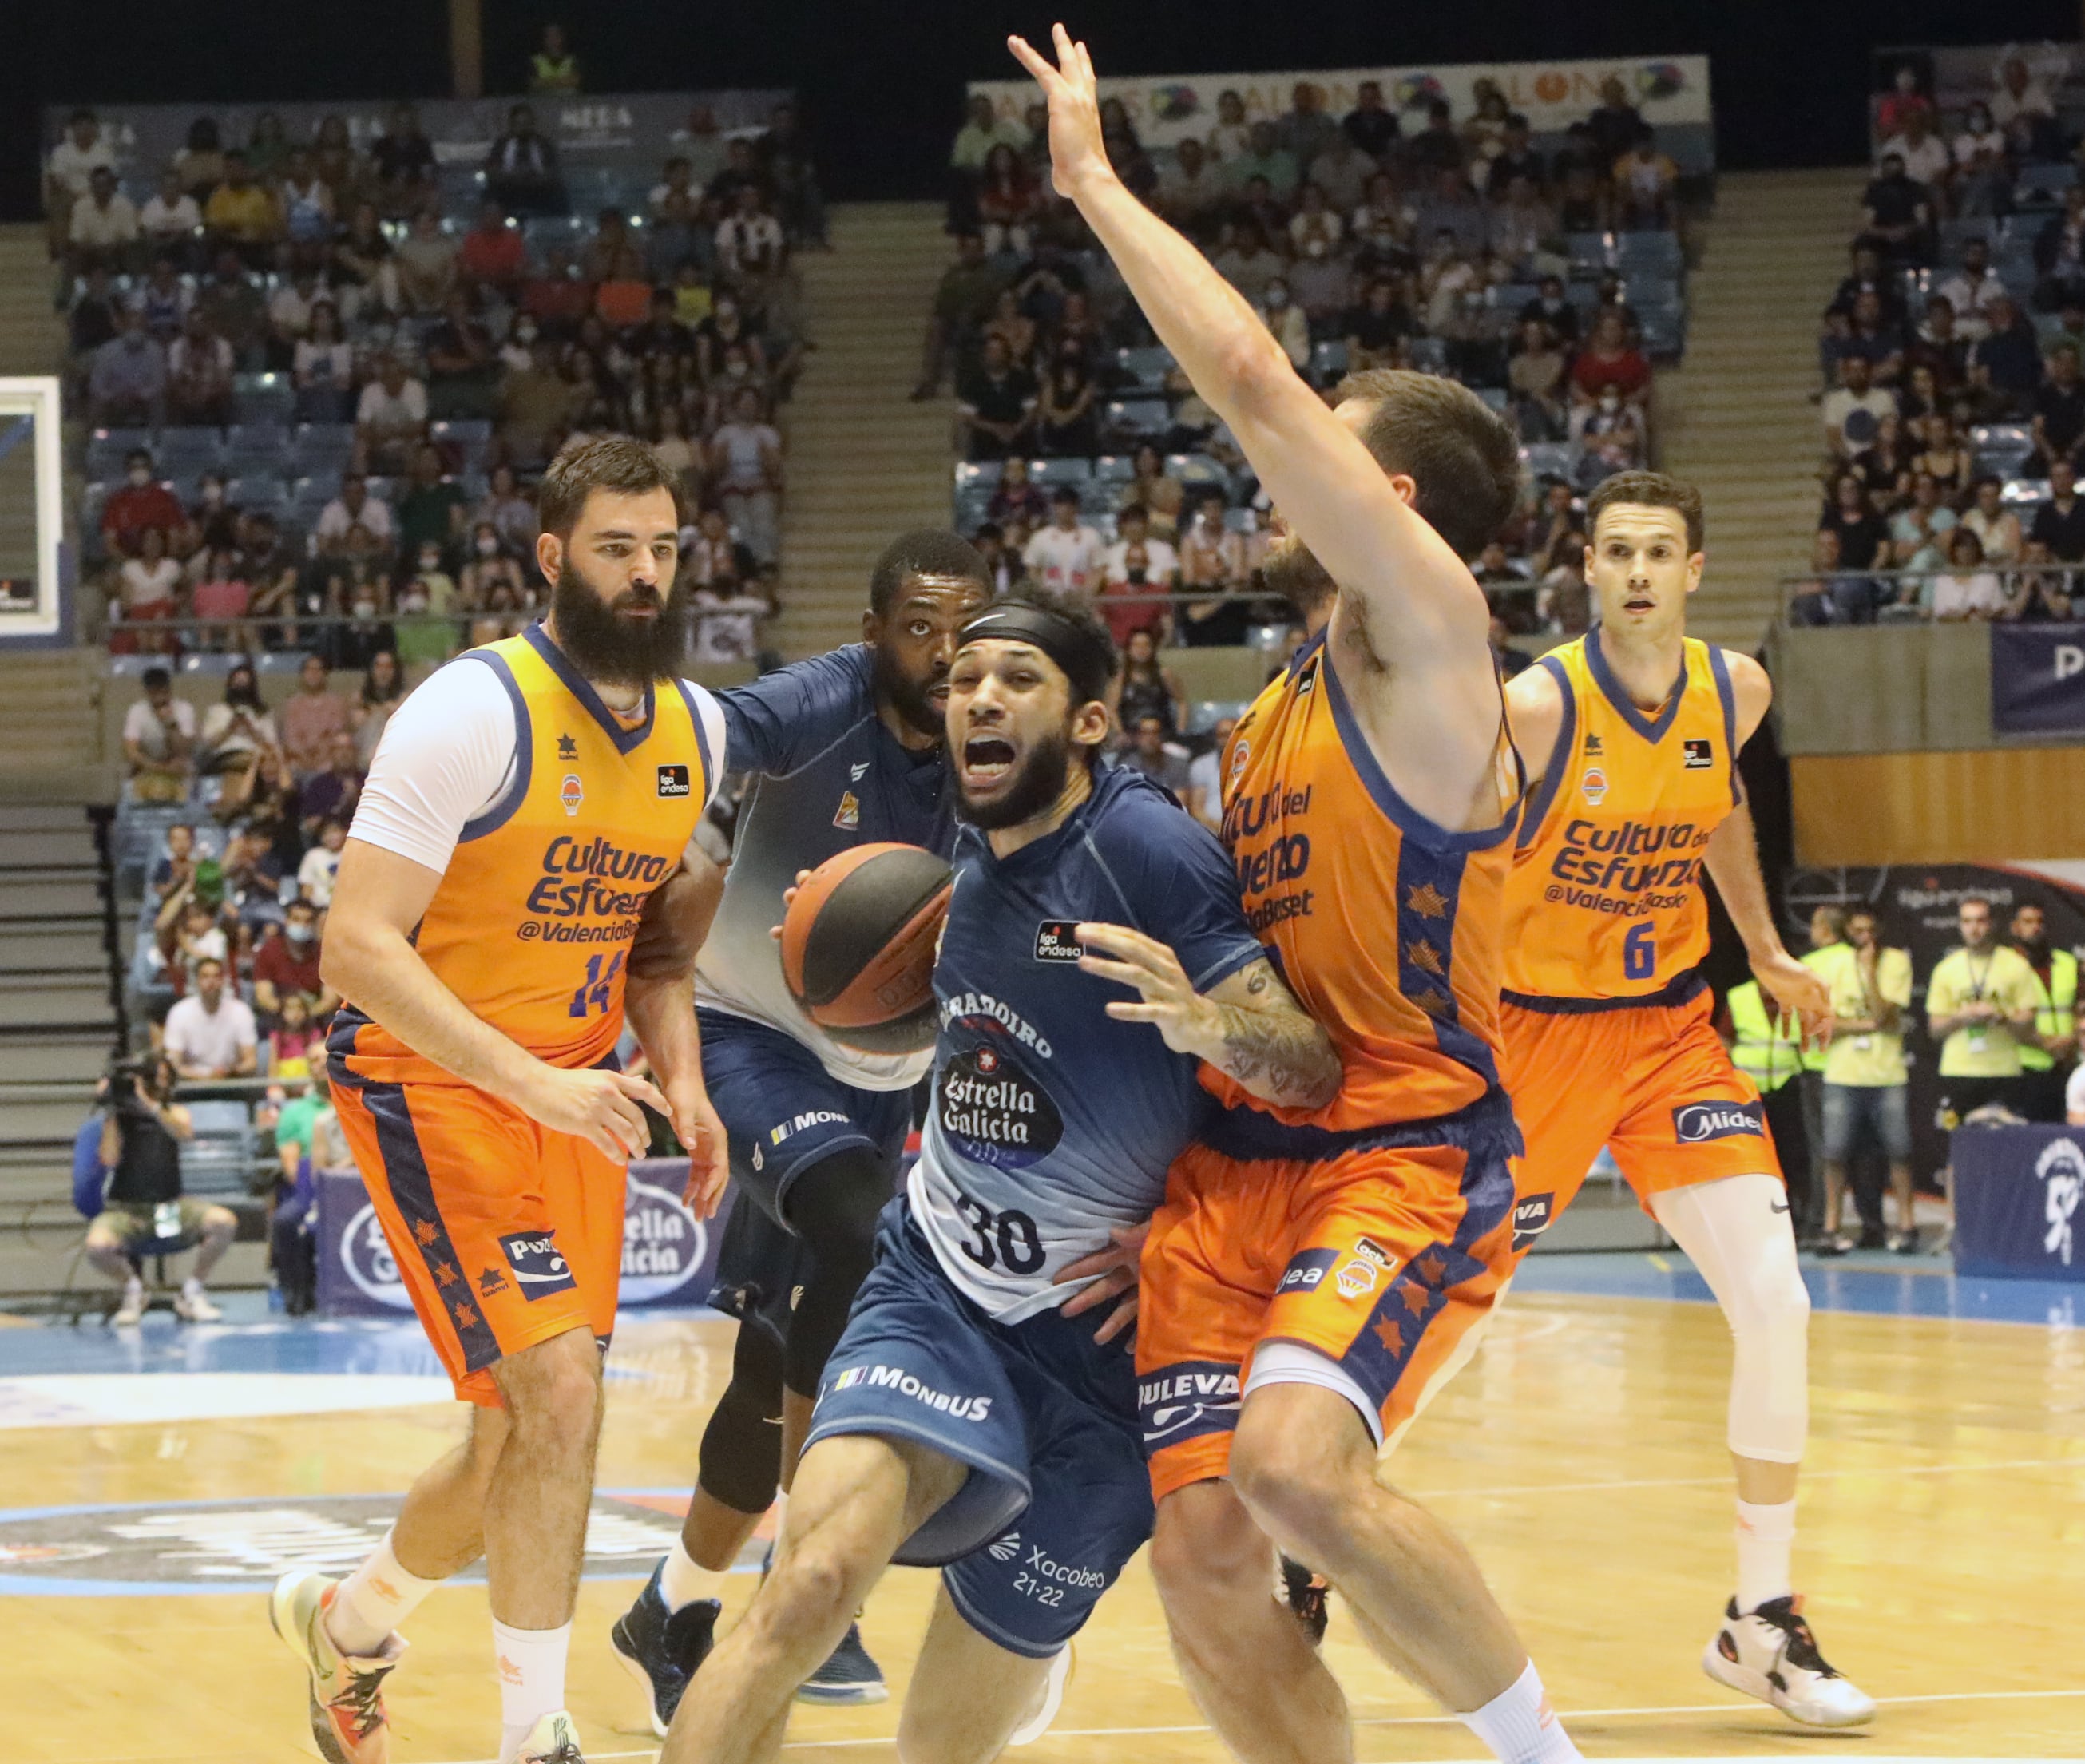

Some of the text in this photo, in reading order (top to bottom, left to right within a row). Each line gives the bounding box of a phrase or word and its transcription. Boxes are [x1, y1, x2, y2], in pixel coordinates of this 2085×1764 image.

[660, 775, 674, 785] liga
[660, 784, 688, 793] endesa
[1038, 945, 1081, 957] endesa
[1040, 933, 1057, 945] liga
[1623, 921, 1655, 980] 6
[569, 950, 624, 1017] 14
[945, 1071, 1036, 1114] Estrella
[794, 1111, 850, 1132] MON
[944, 1100, 1029, 1144] Galicia
[1687, 1108, 1762, 1137] Mide
[624, 1208, 685, 1239] ella
[958, 1195, 1046, 1275] 30
[482, 1282, 509, 1298] luanvi
[867, 1365, 993, 1421] MONBUS
[1025, 1544, 1105, 1588] Xacobeo
